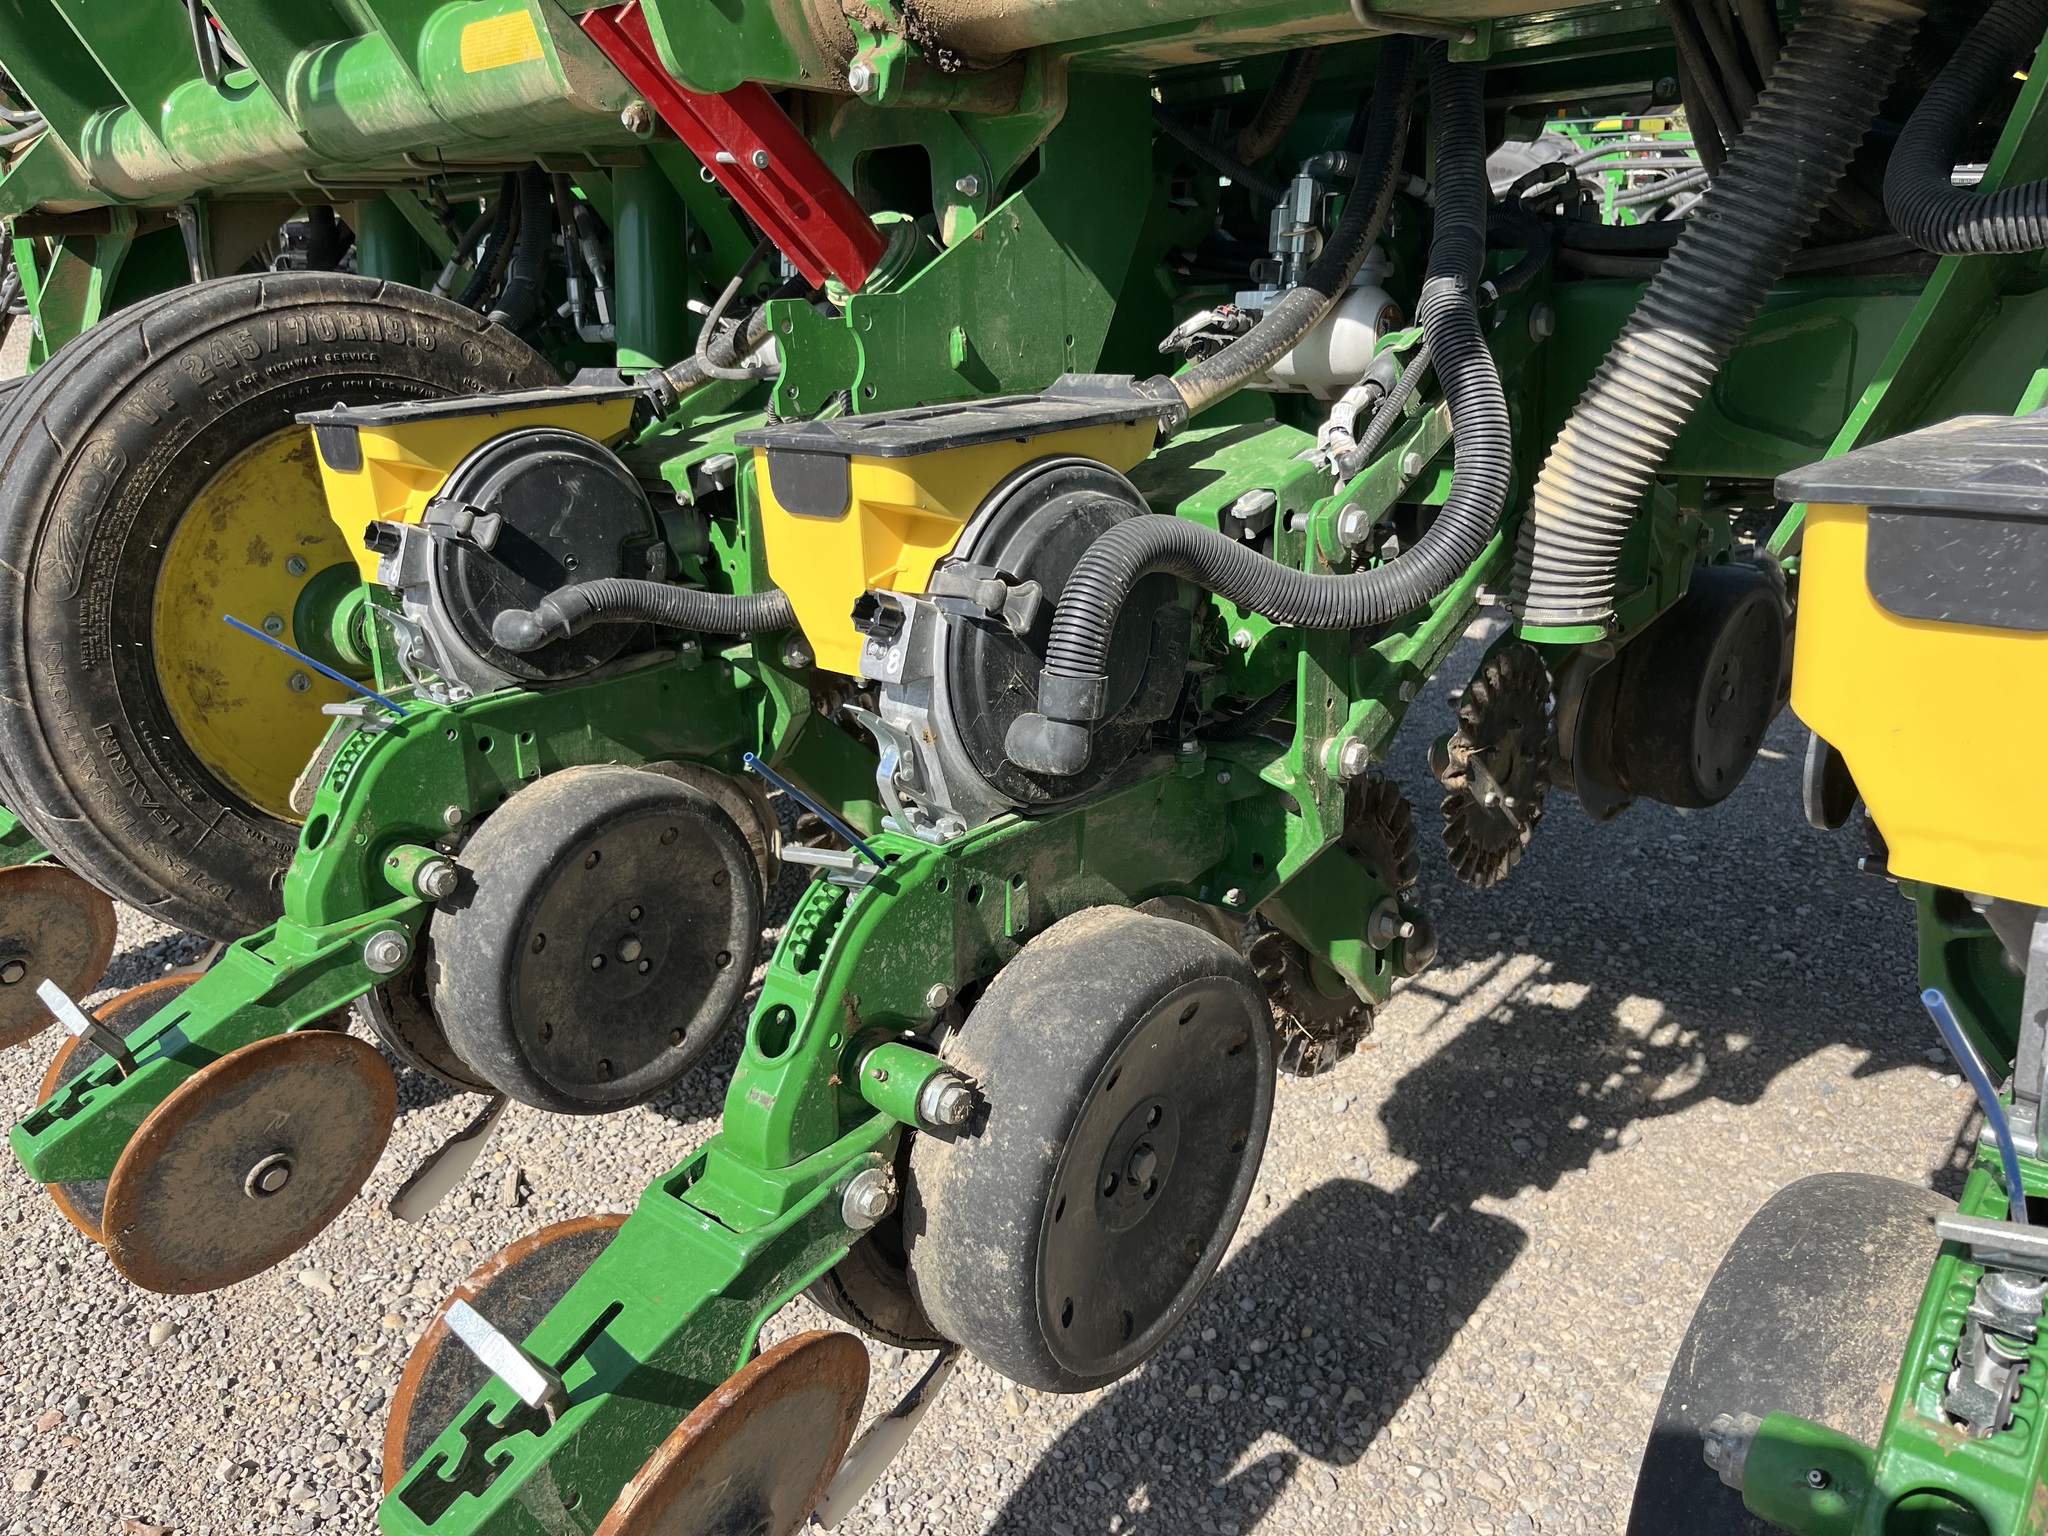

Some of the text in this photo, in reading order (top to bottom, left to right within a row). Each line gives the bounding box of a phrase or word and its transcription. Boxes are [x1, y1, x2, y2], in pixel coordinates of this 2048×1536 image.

[886, 648, 901, 674] 8
[43, 641, 236, 901] DESTINATION
[93, 722, 185, 837] FARM
